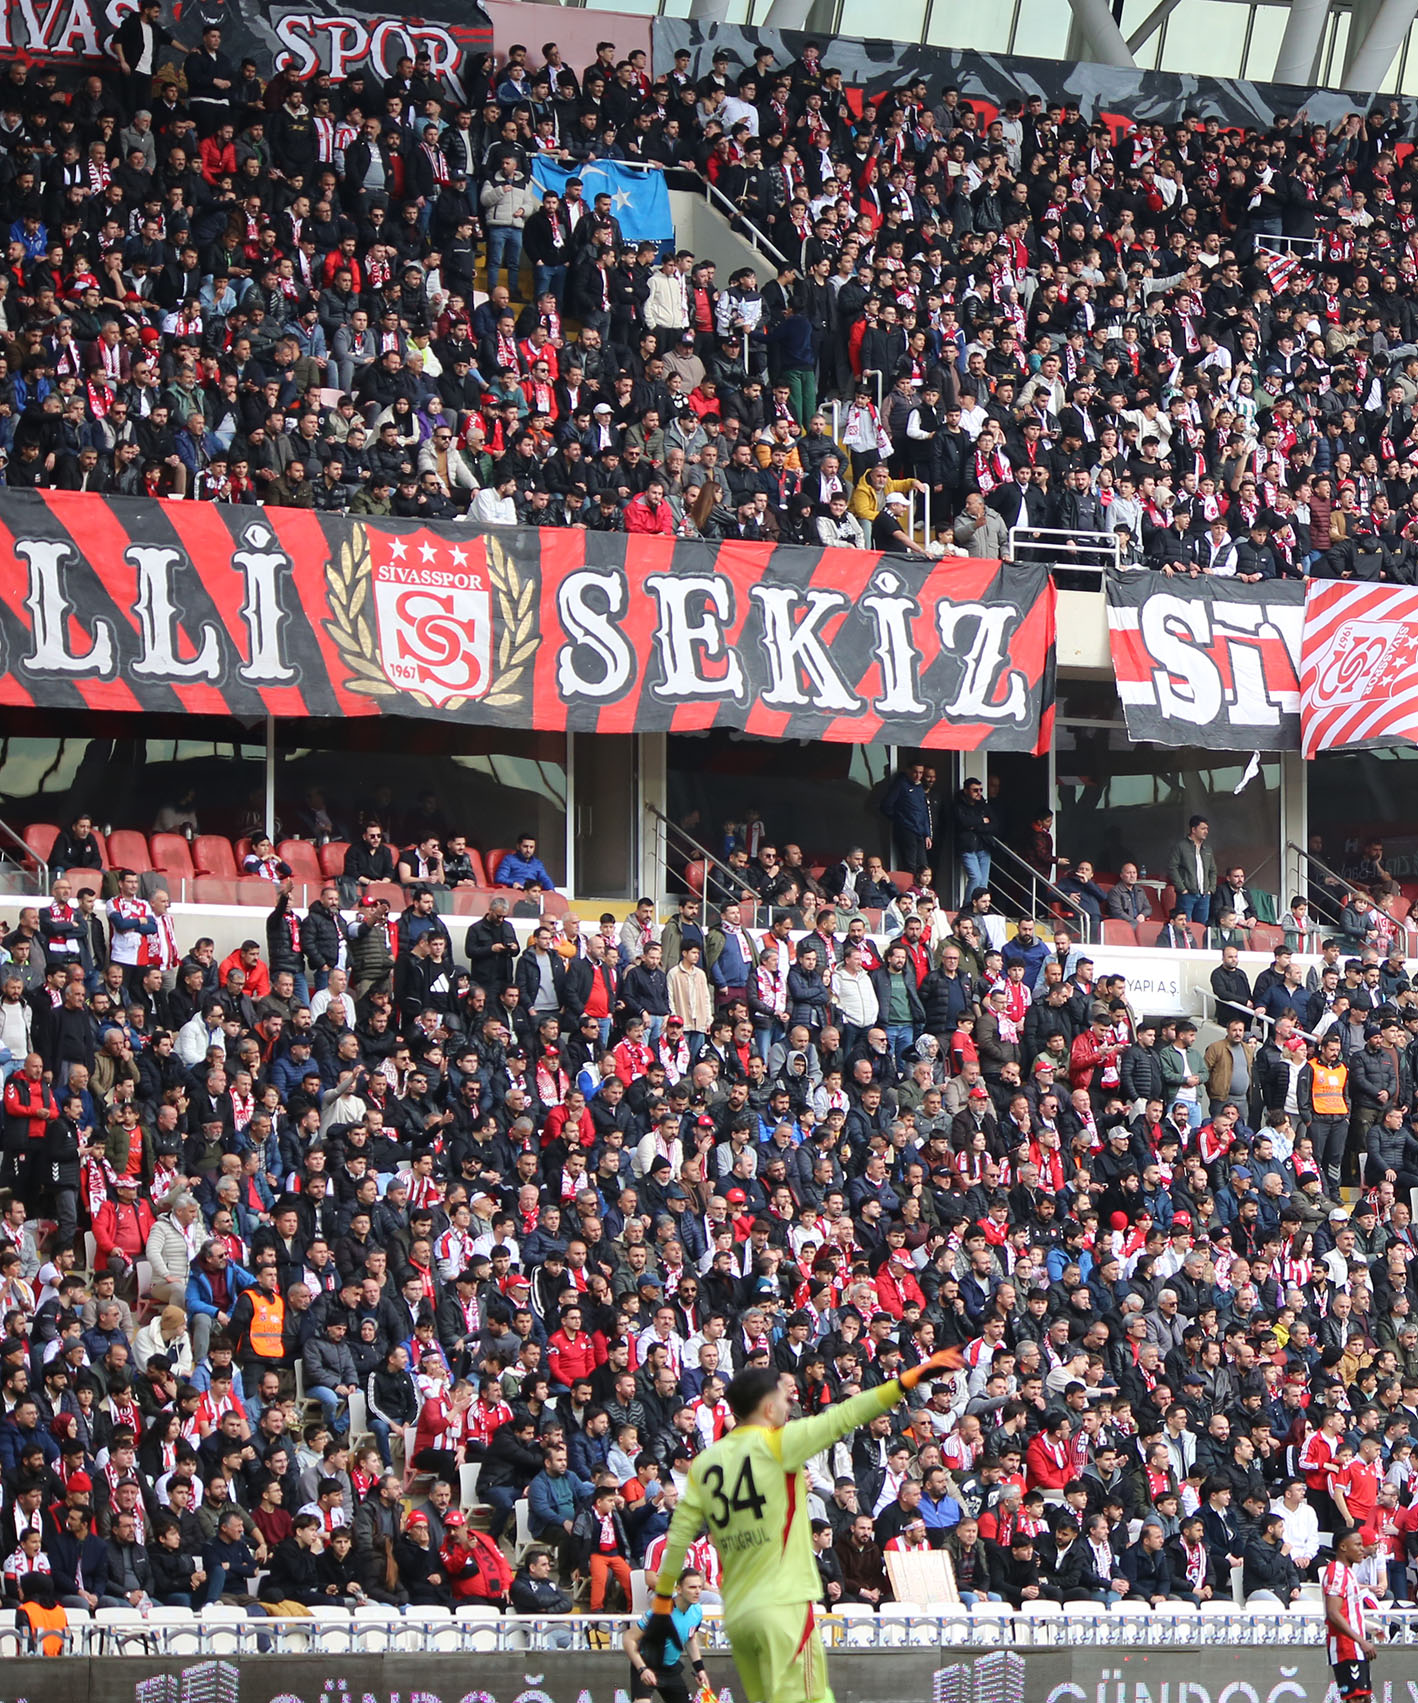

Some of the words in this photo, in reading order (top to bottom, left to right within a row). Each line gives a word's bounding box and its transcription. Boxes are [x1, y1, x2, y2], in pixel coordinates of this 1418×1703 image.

[275, 14, 467, 104] SPOR
[378, 561, 483, 591] SİVASSPOR
[12, 522, 297, 684] LLİ
[556, 568, 1029, 723] SEKİZ
[389, 664, 417, 680] 1967
[1363, 625, 1410, 697] SİVASSPOR
[1127, 979, 1154, 993] YAPI
[702, 1455, 767, 1529] 34
